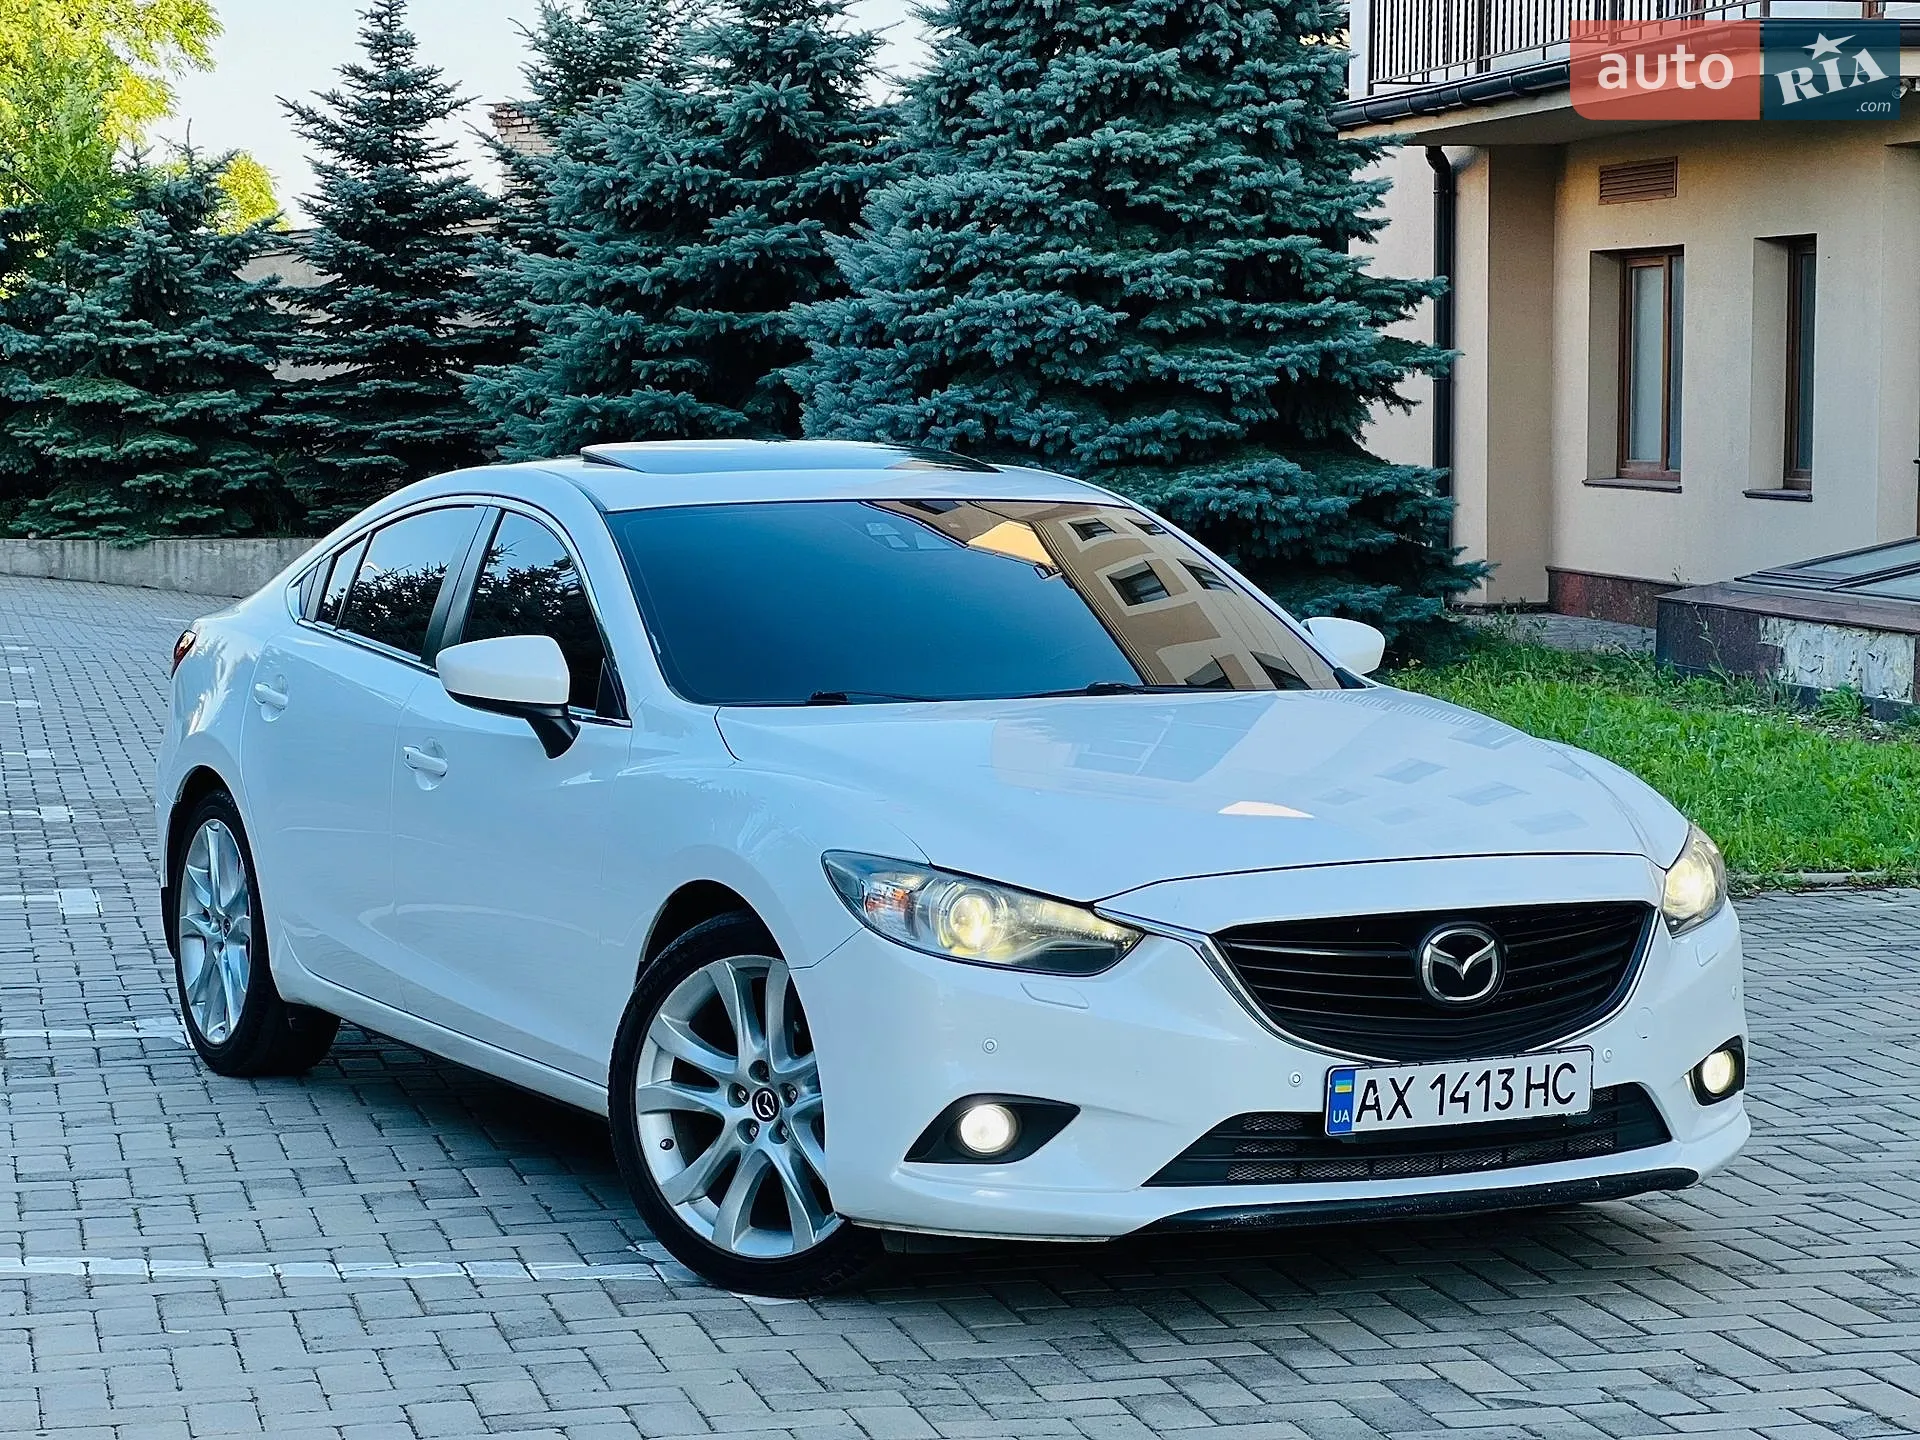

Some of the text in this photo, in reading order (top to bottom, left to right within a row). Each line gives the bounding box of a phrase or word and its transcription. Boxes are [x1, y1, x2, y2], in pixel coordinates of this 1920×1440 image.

[1355, 1063, 1577, 1123] AX 1413 HC
[1333, 1109, 1350, 1124] UA
